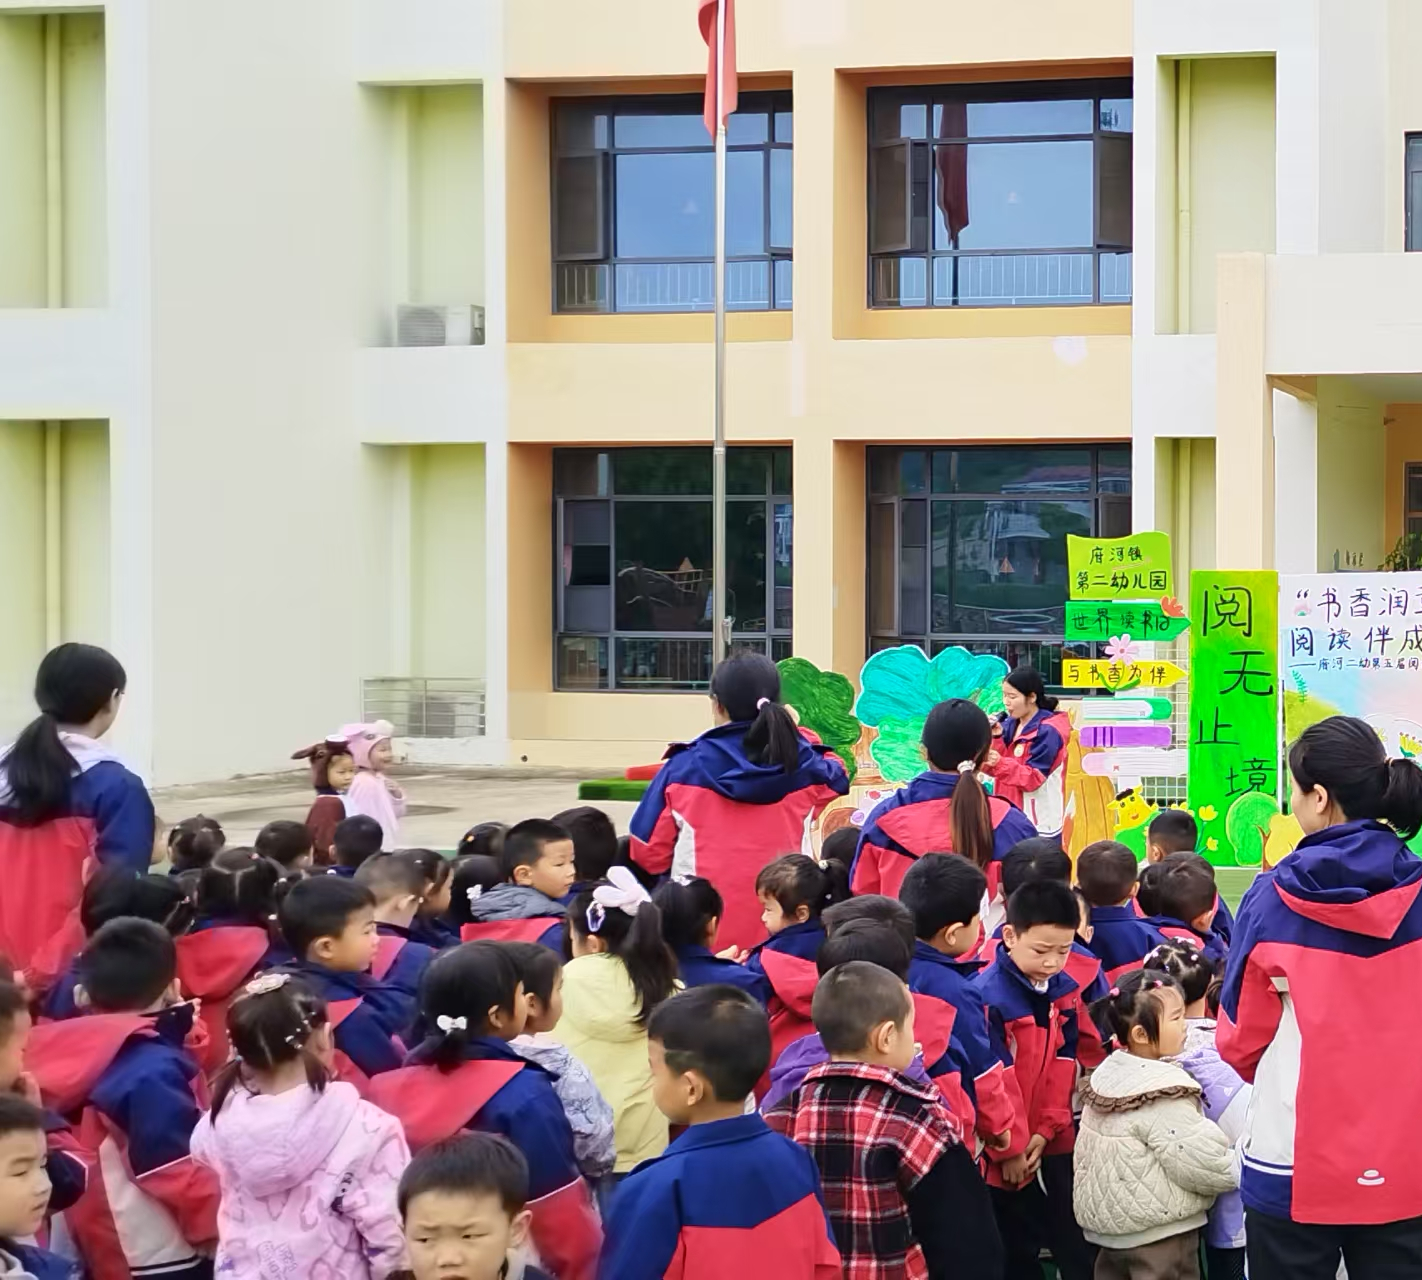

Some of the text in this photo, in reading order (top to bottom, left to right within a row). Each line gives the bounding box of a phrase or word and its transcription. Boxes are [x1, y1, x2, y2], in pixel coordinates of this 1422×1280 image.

[1089, 546, 1143, 565] 府河镇
[1076, 570, 1167, 594] 第二幼儿园
[1068, 663, 1168, 685] 与书香为伴
[1193, 584, 1278, 797] 阅无止境
